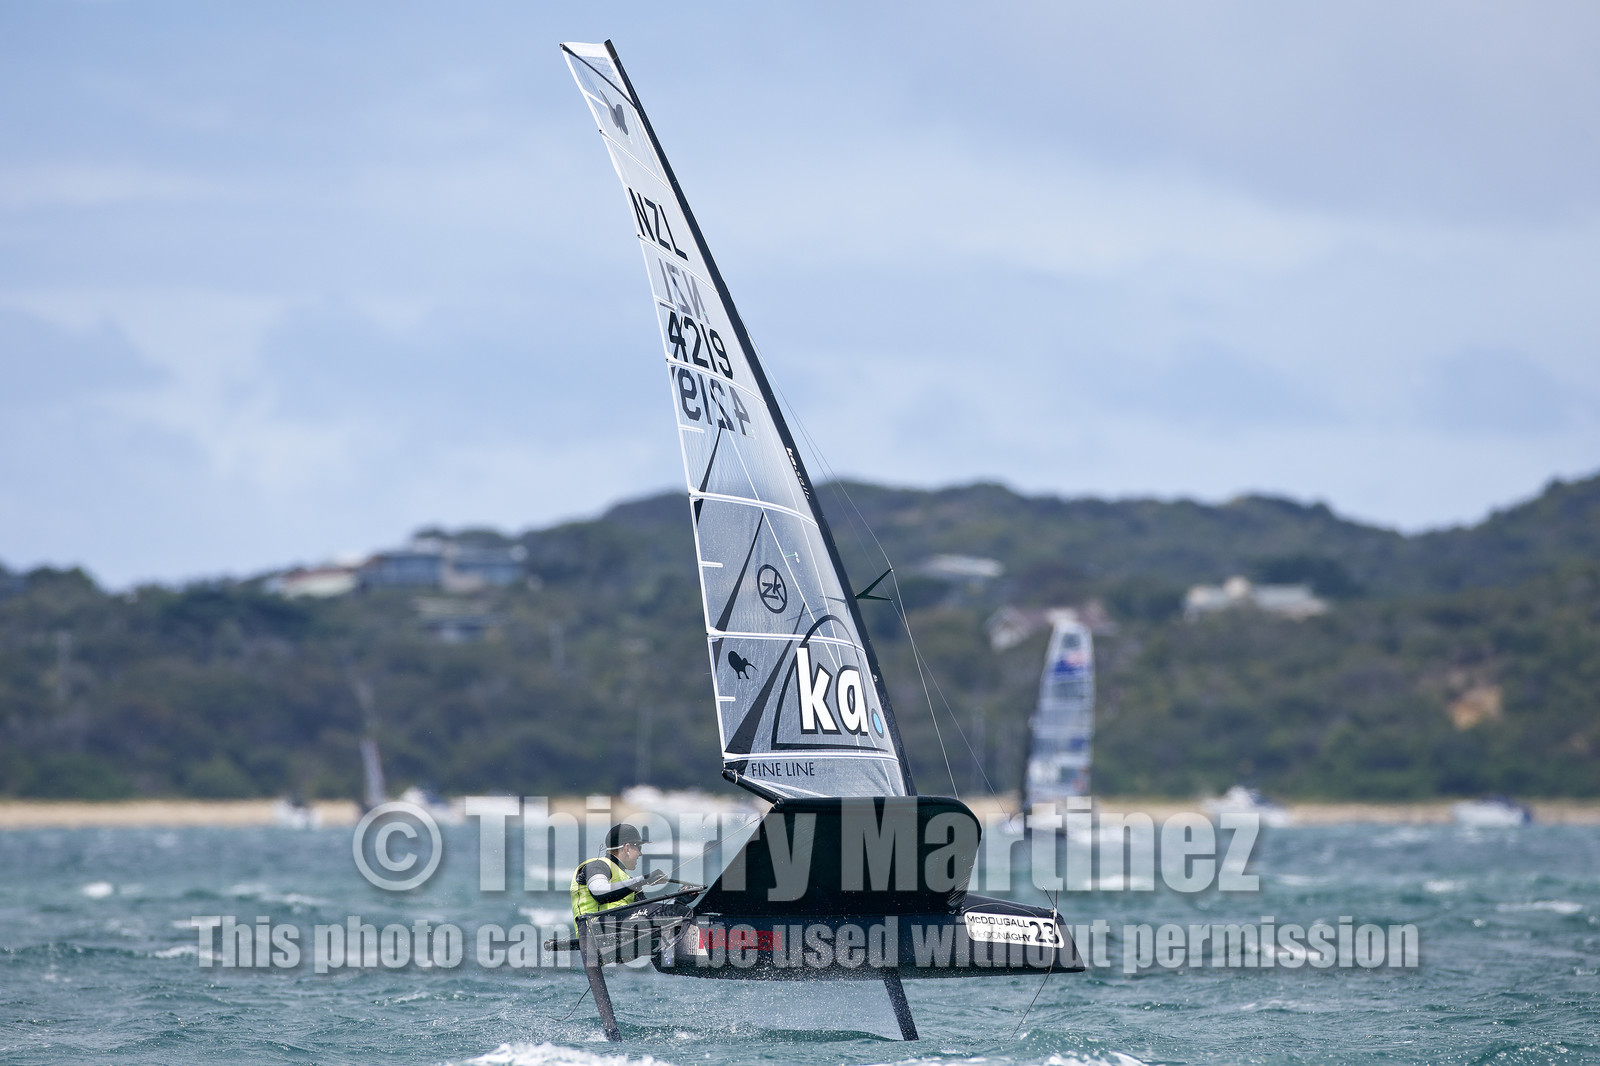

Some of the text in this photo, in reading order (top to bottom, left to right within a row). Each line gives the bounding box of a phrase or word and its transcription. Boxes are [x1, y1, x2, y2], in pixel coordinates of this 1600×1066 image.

[628, 187, 688, 261] NZL
[668, 311, 733, 380] 4219
[751, 761, 815, 777] FINE LINE
[966, 915, 1029, 928] McDOUGALL
[1029, 921, 1060, 944] 23
[699, 928, 782, 951] HARKEN
